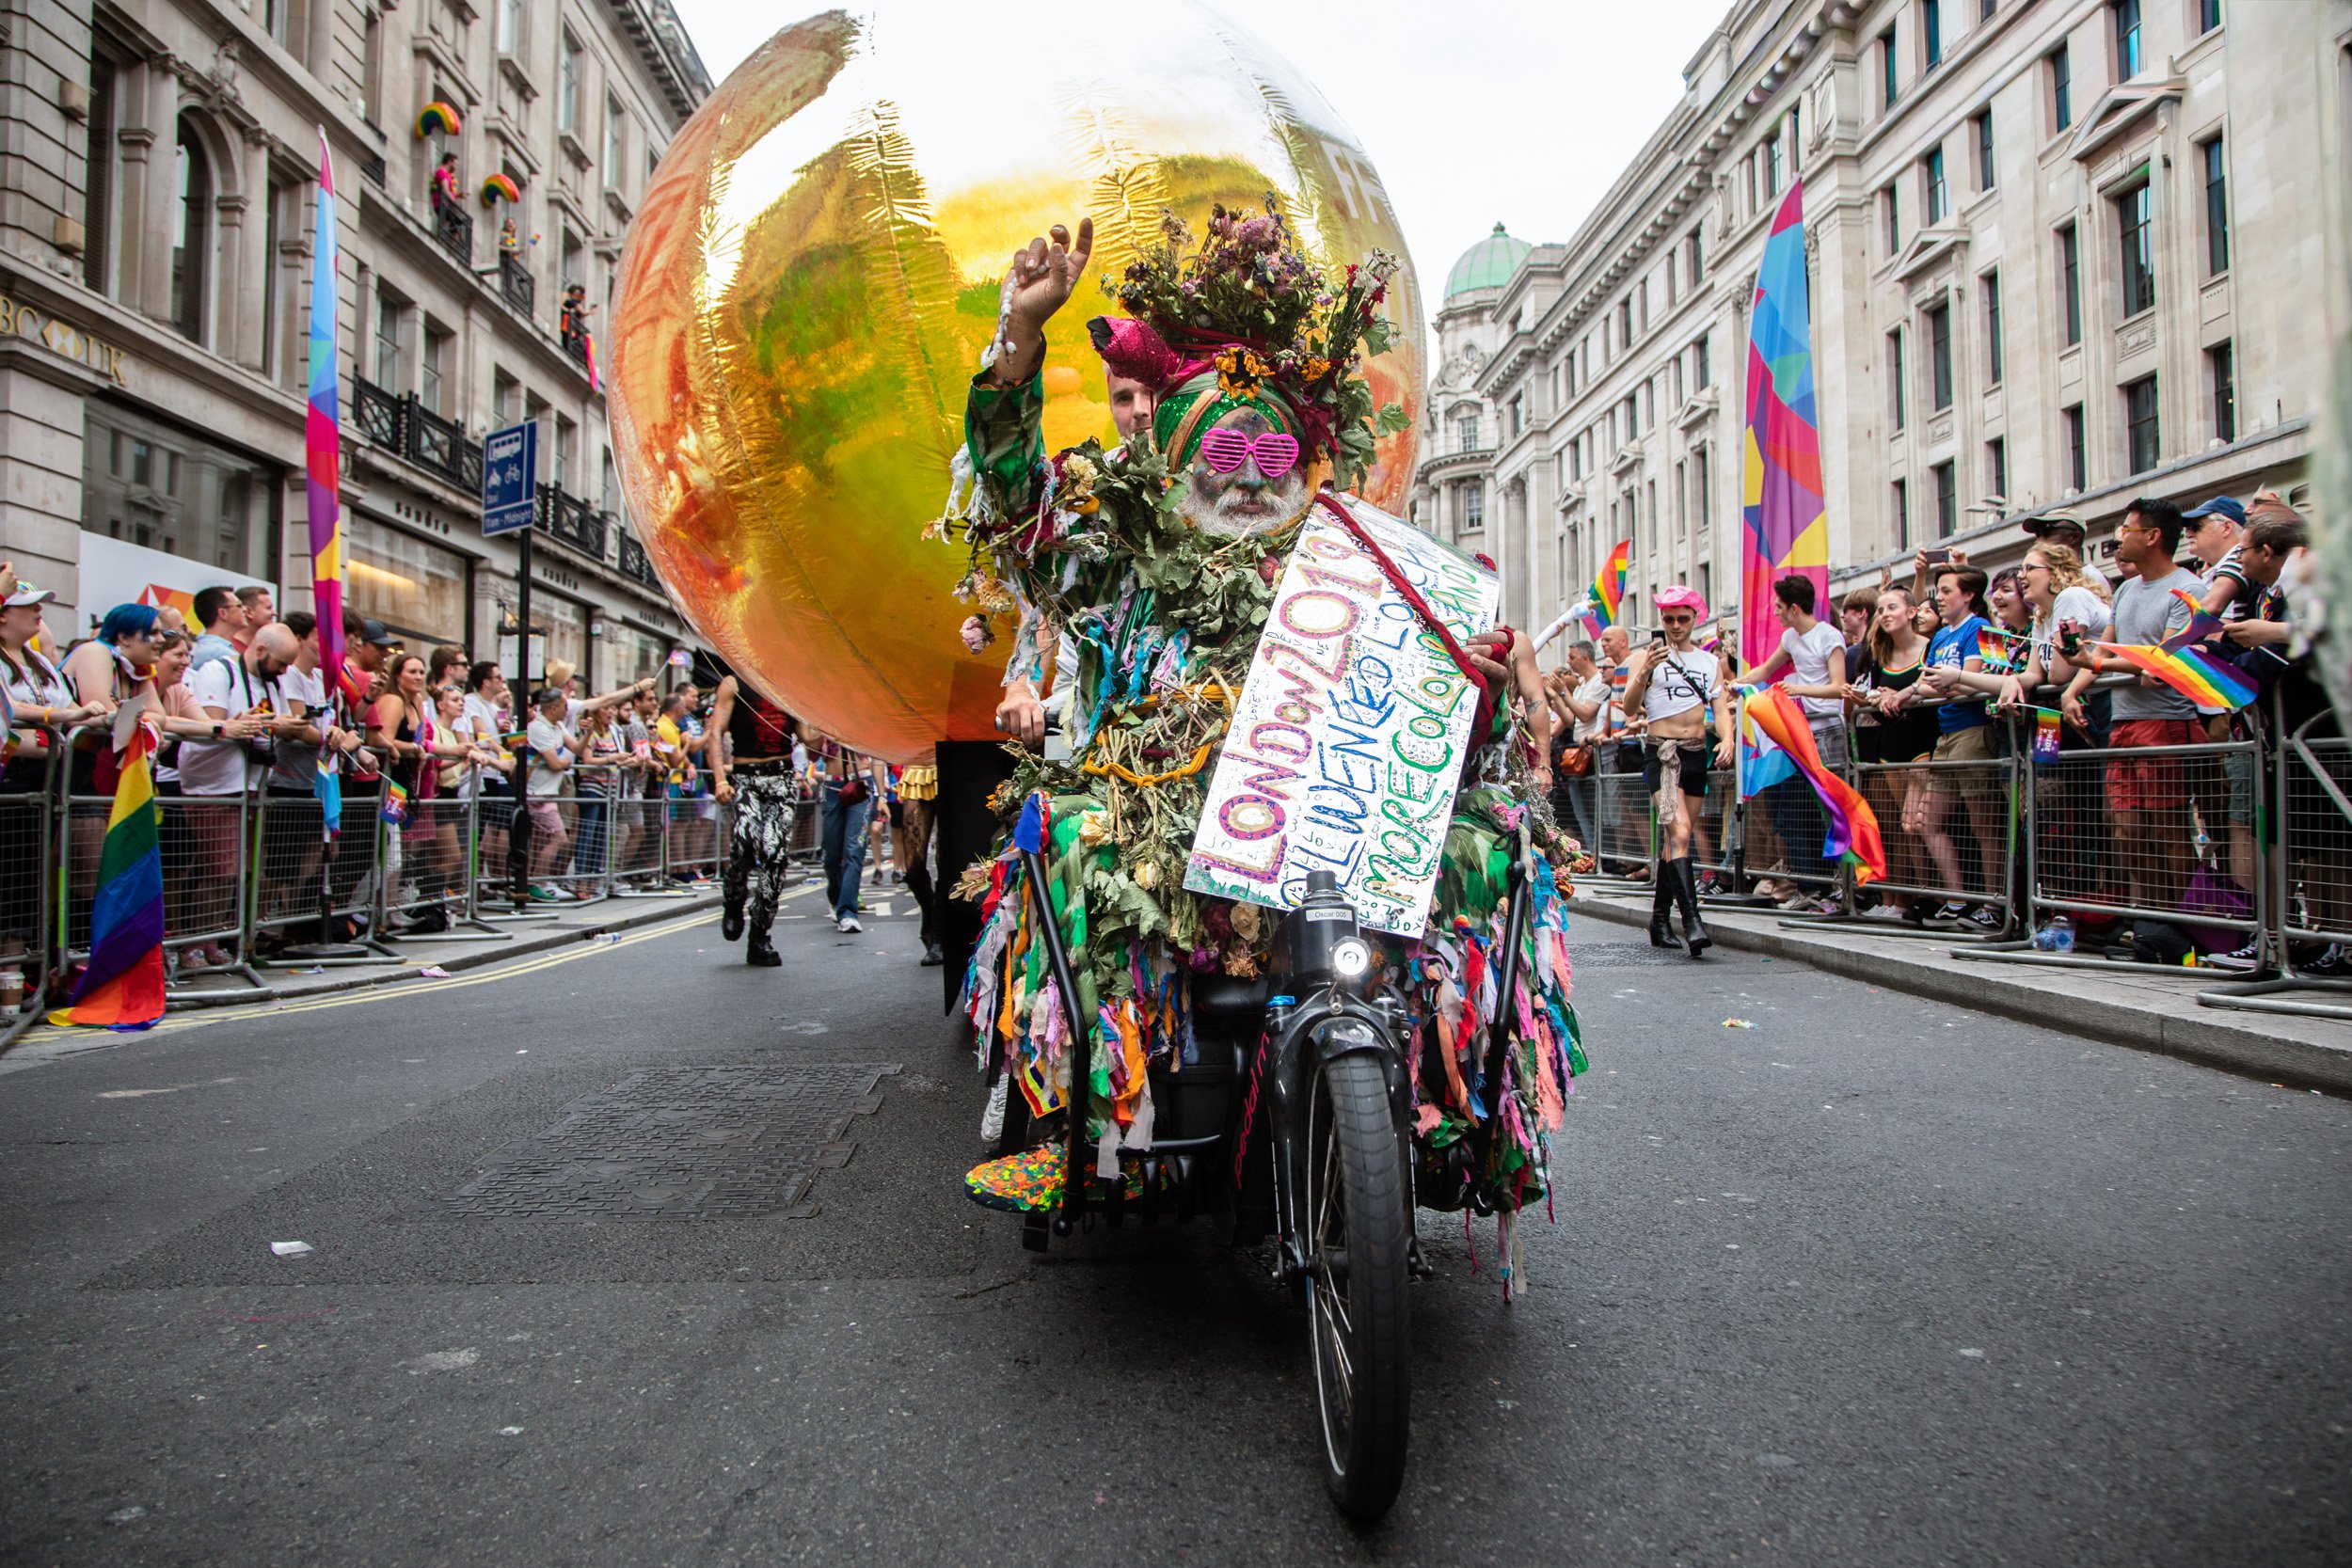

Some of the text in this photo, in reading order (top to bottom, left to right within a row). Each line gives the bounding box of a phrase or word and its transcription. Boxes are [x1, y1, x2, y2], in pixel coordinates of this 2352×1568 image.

[86, 335, 127, 388] UK
[395, 500, 450, 535] sandro
[503, 509, 532, 526] Midnight
[1361, 760, 1447, 908] MORE
[1426, 564, 1484, 615] AND
[1192, 667, 1324, 883] LONDON
